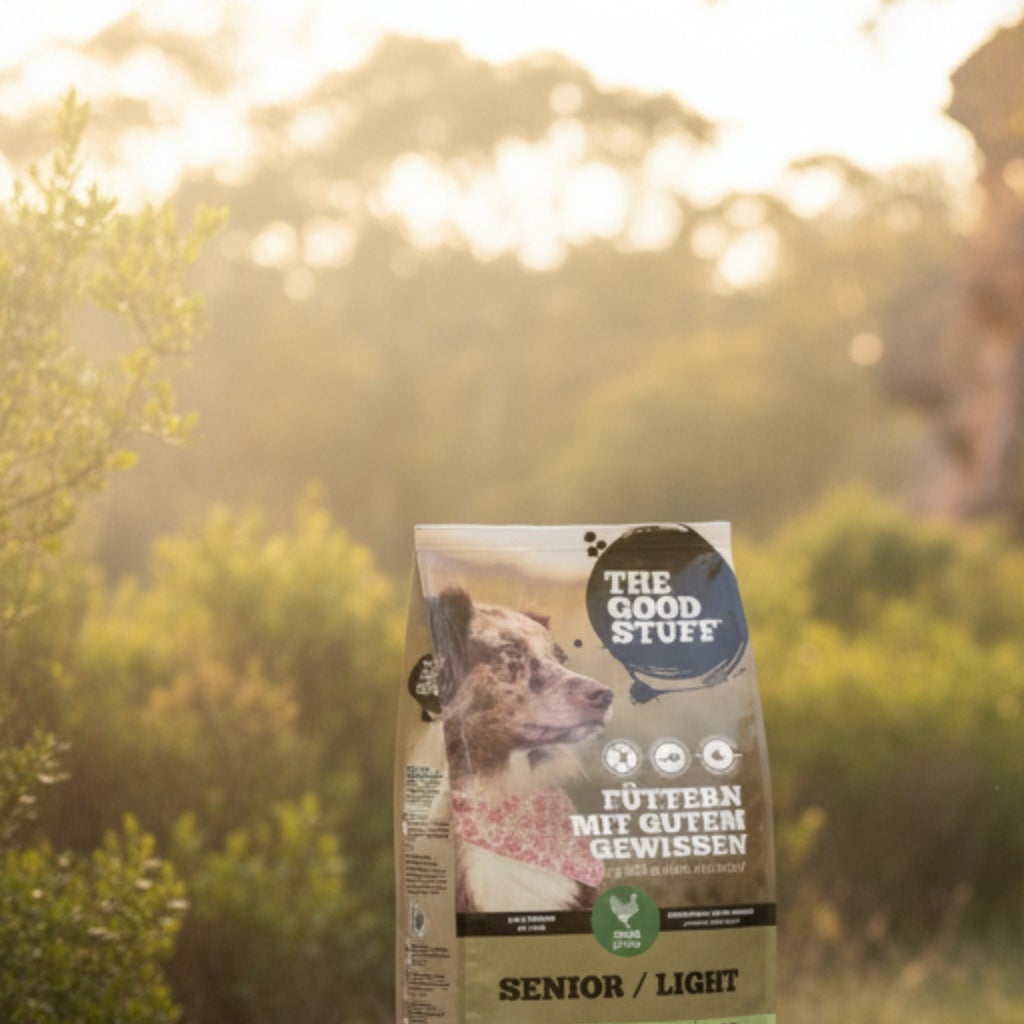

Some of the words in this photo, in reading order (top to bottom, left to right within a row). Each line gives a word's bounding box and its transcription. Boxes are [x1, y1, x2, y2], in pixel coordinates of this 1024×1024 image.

[604, 570, 671, 595] THE
[607, 596, 702, 620] GOOD
[611, 619, 720, 645] STUFF
[570, 813, 632, 837] MIT
[589, 834, 748, 860] GEWISSEN
[499, 975, 624, 1001] SENIOR
[633, 971, 648, 999] /
[655, 968, 739, 996] LIGHT
